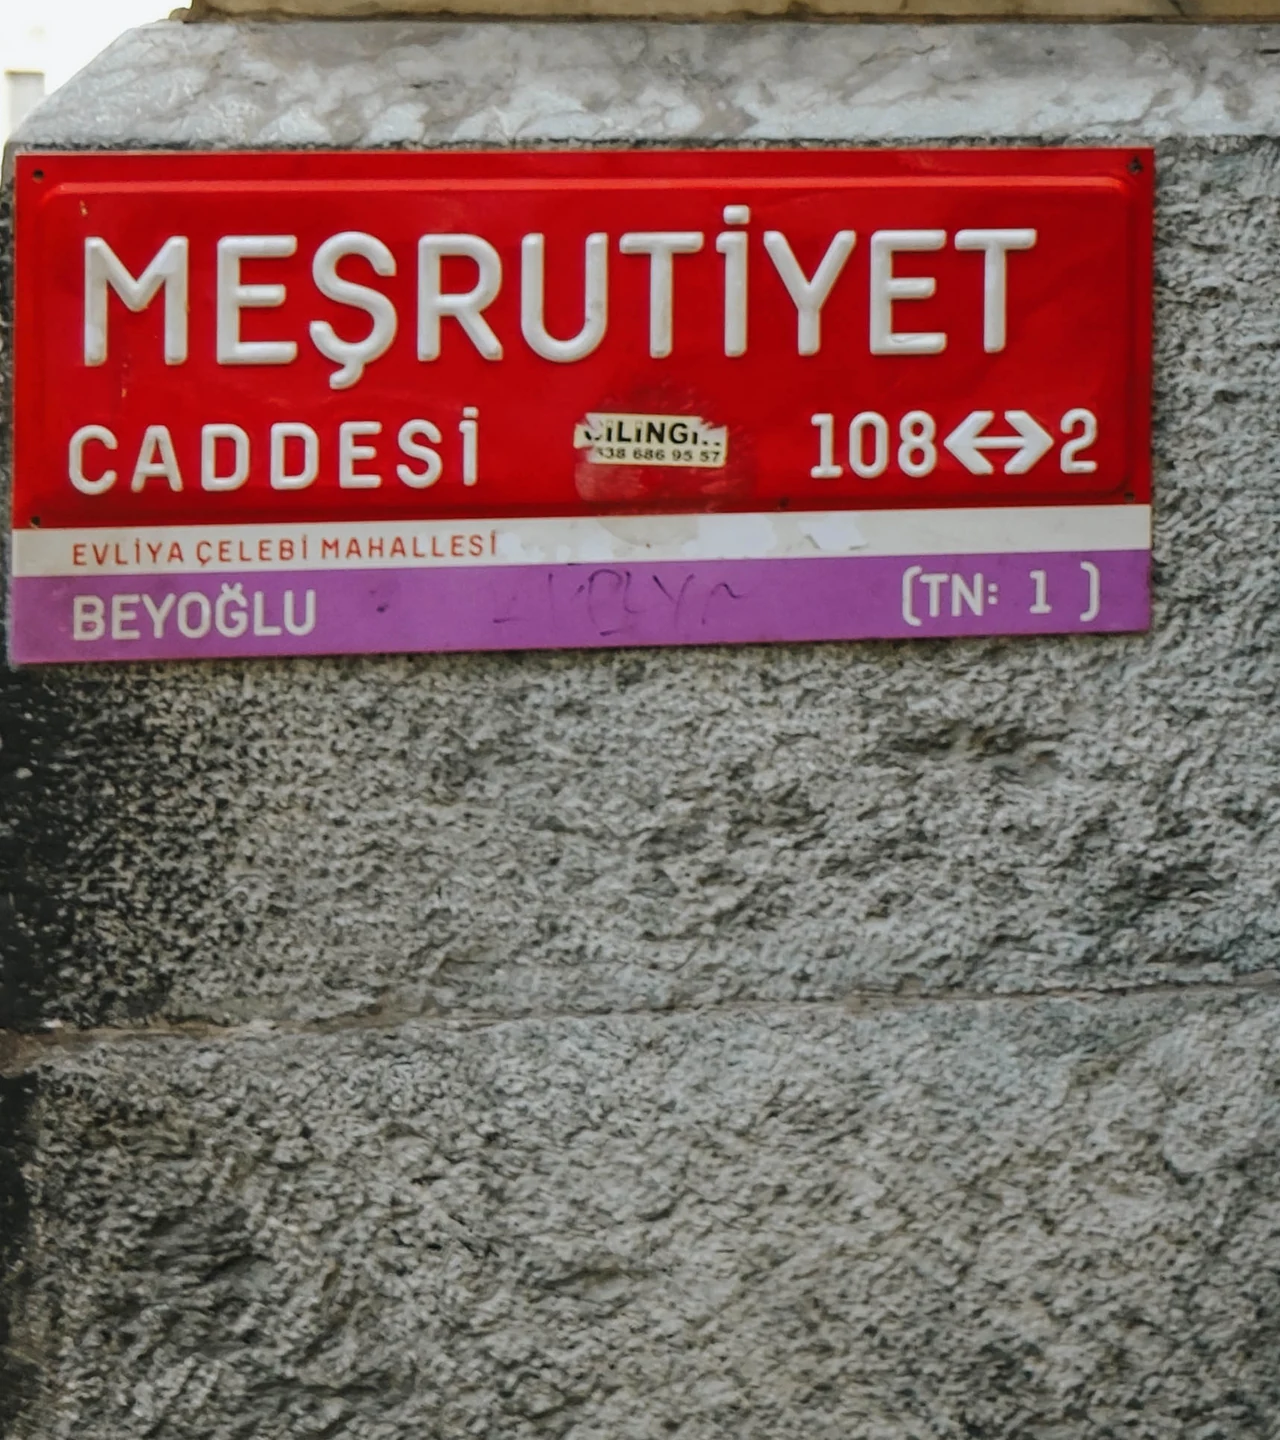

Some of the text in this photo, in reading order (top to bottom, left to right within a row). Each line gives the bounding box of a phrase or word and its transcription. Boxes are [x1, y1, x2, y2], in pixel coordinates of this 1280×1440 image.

[83, 204, 1038, 390] MEŞRUTİYET
[68, 406, 479, 495] CADDESİ
[633, 448, 666, 460] 686
[672, 449, 693, 462] 95
[700, 450, 721, 463] 57
[71, 529, 498, 566] EVLİYA ÇELEBİ MAHALLESİ
[73, 582, 317, 641] BEYOĞLU
